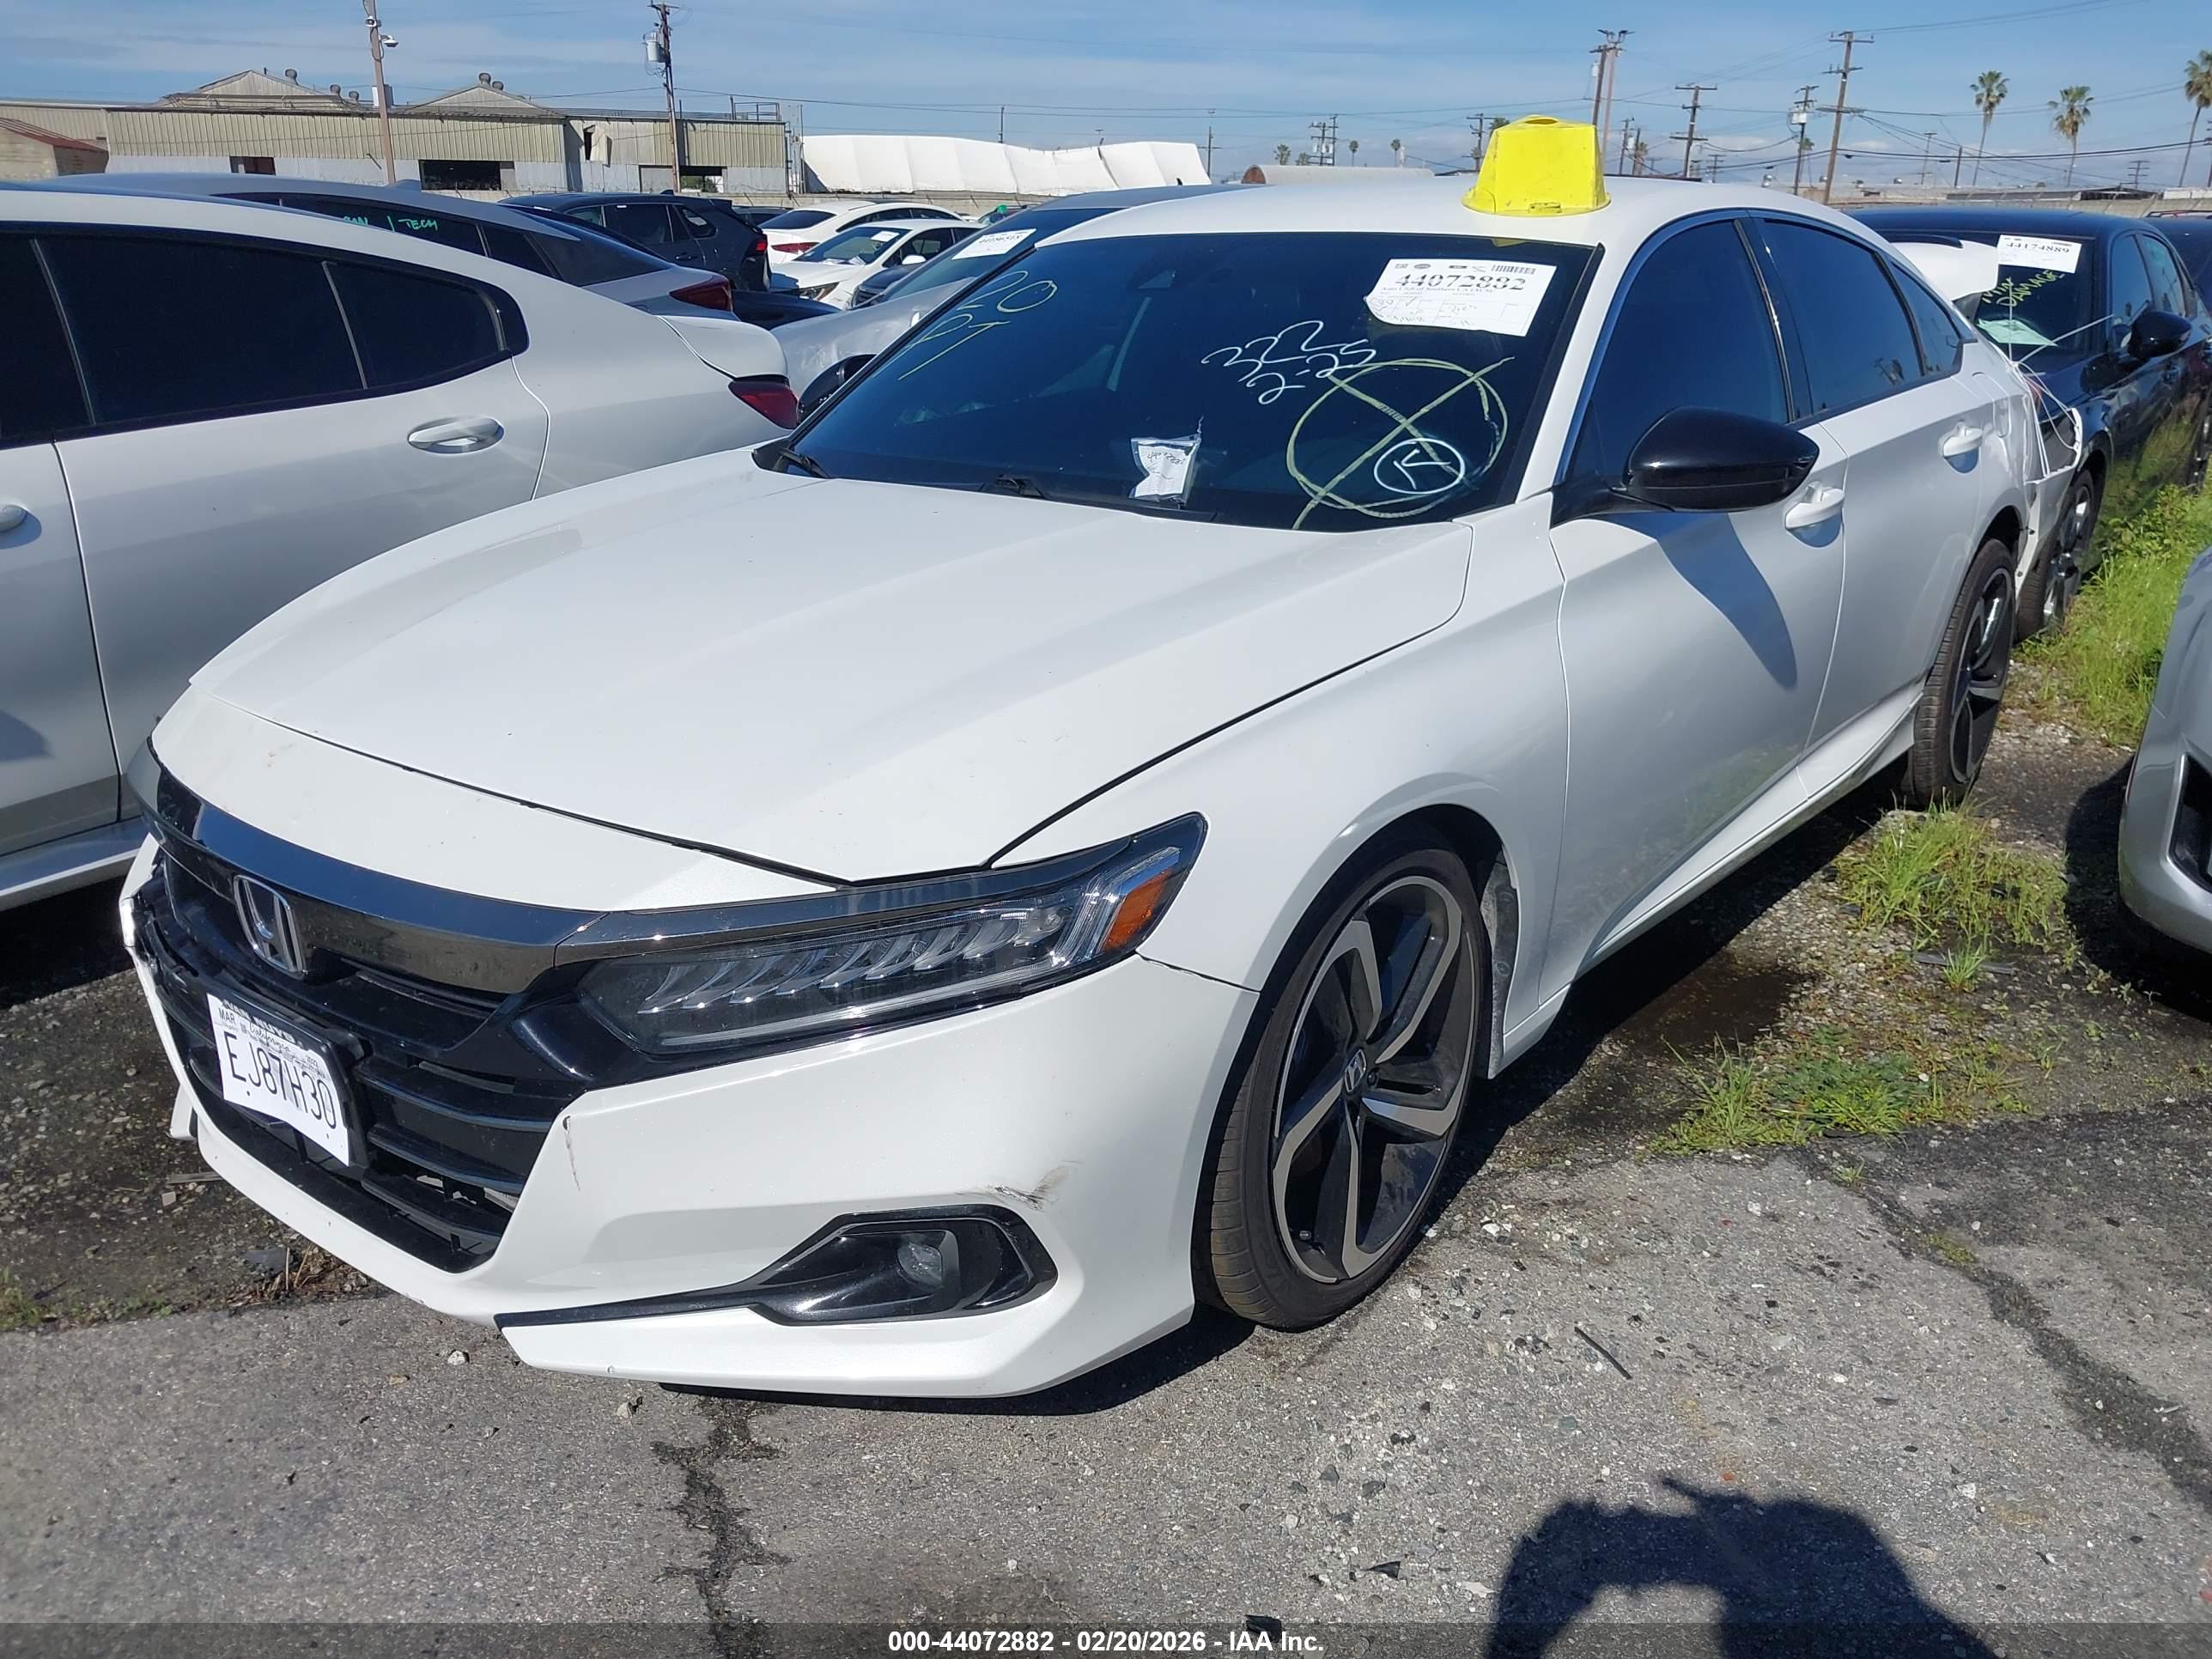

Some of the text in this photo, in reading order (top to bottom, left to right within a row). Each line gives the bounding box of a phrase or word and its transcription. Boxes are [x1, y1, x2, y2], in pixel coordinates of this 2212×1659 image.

[1394, 274, 1526, 290] 44072882
[218, 1007, 236, 1024] MAR
[224, 1030, 337, 1129] EJ87H30
